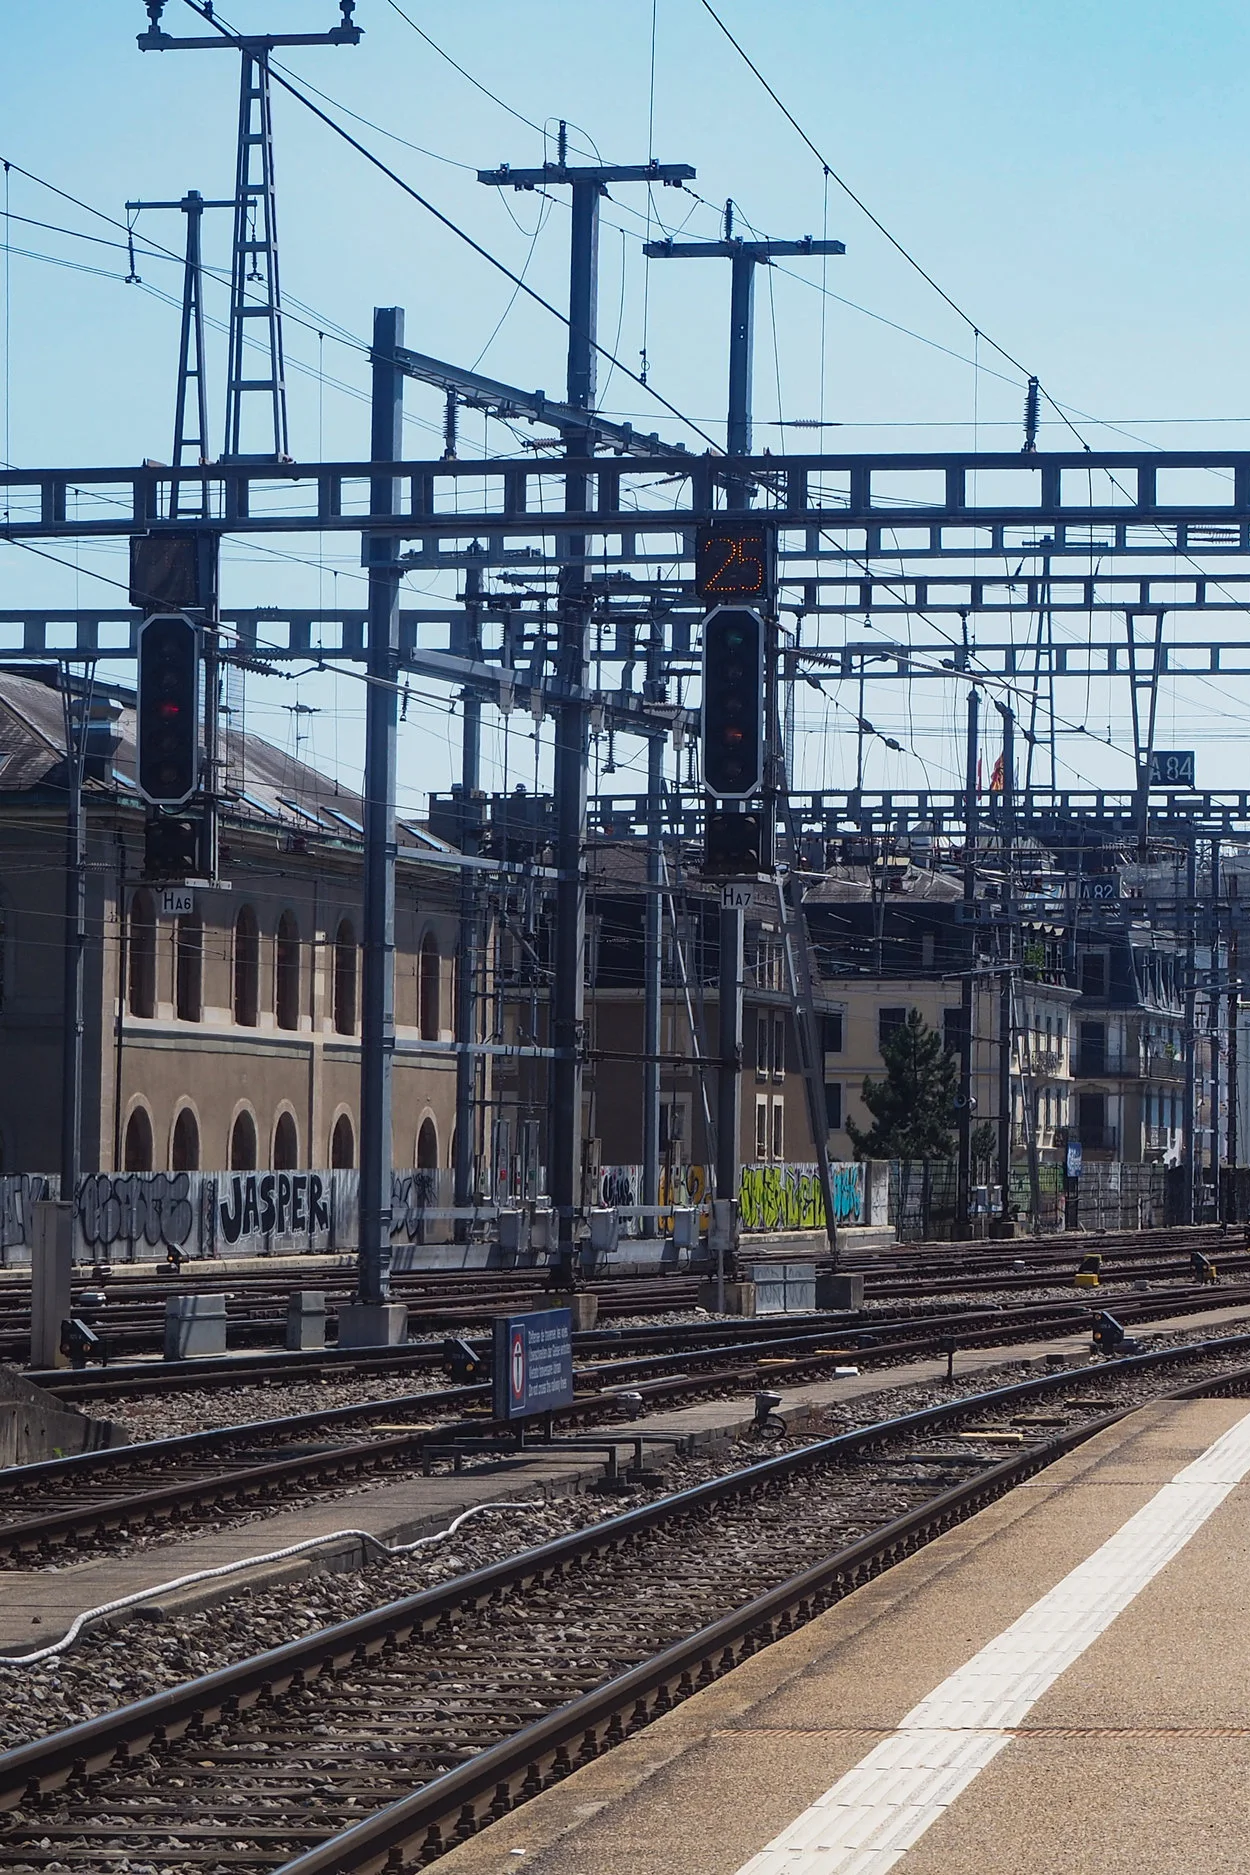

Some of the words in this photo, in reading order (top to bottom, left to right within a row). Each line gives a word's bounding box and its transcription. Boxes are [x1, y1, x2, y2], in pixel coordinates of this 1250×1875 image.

[704, 537, 764, 591] 25
[1166, 756, 1193, 781] 84
[219, 1173, 330, 1244] JASPER
